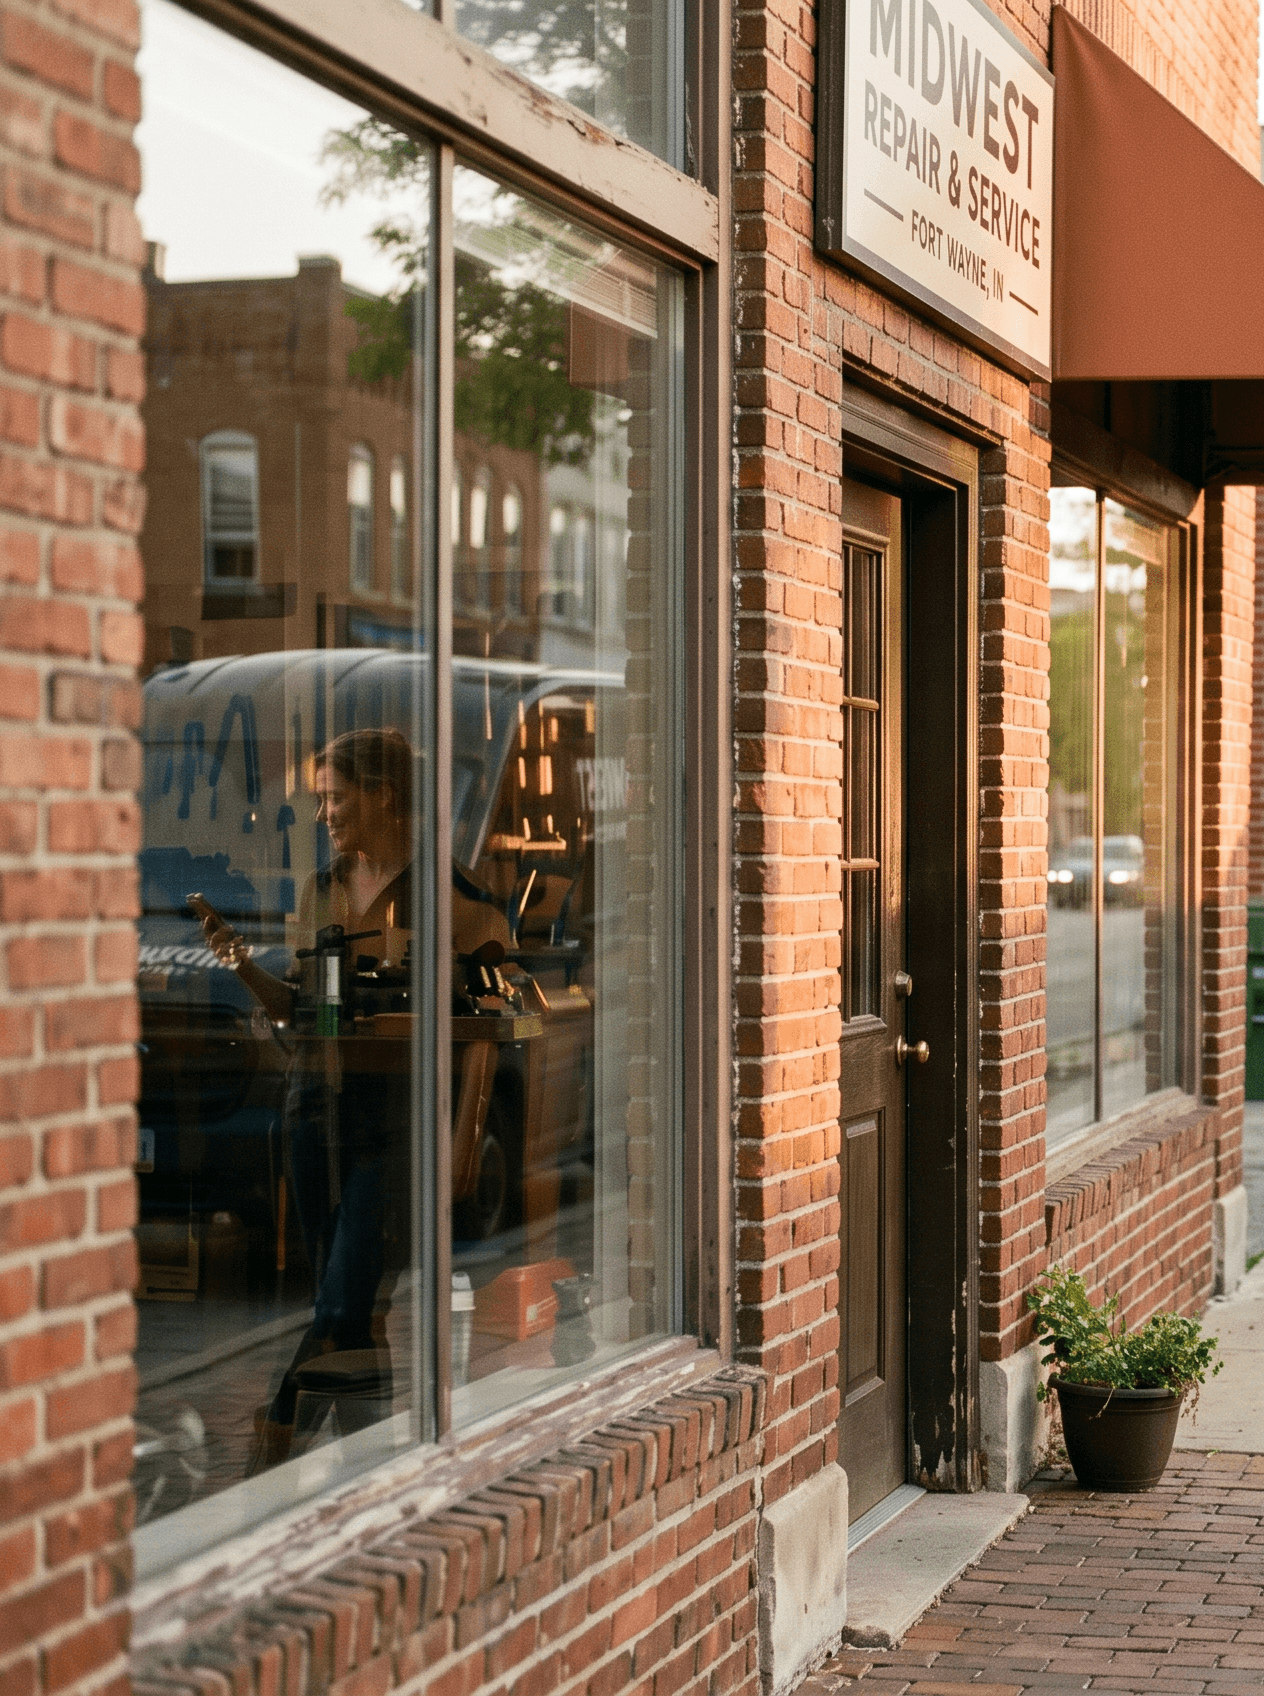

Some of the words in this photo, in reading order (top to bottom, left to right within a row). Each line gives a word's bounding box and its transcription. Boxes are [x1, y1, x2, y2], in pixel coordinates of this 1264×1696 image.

[864, 79, 941, 195] REPAIR
[949, 150, 962, 209] &
[967, 166, 1041, 270] SERVICE
[869, 0, 1039, 190] MIDWEST
[911, 209, 943, 260] FORT
[947, 233, 990, 300] WAYNE,
[993, 268, 1004, 303] IN
